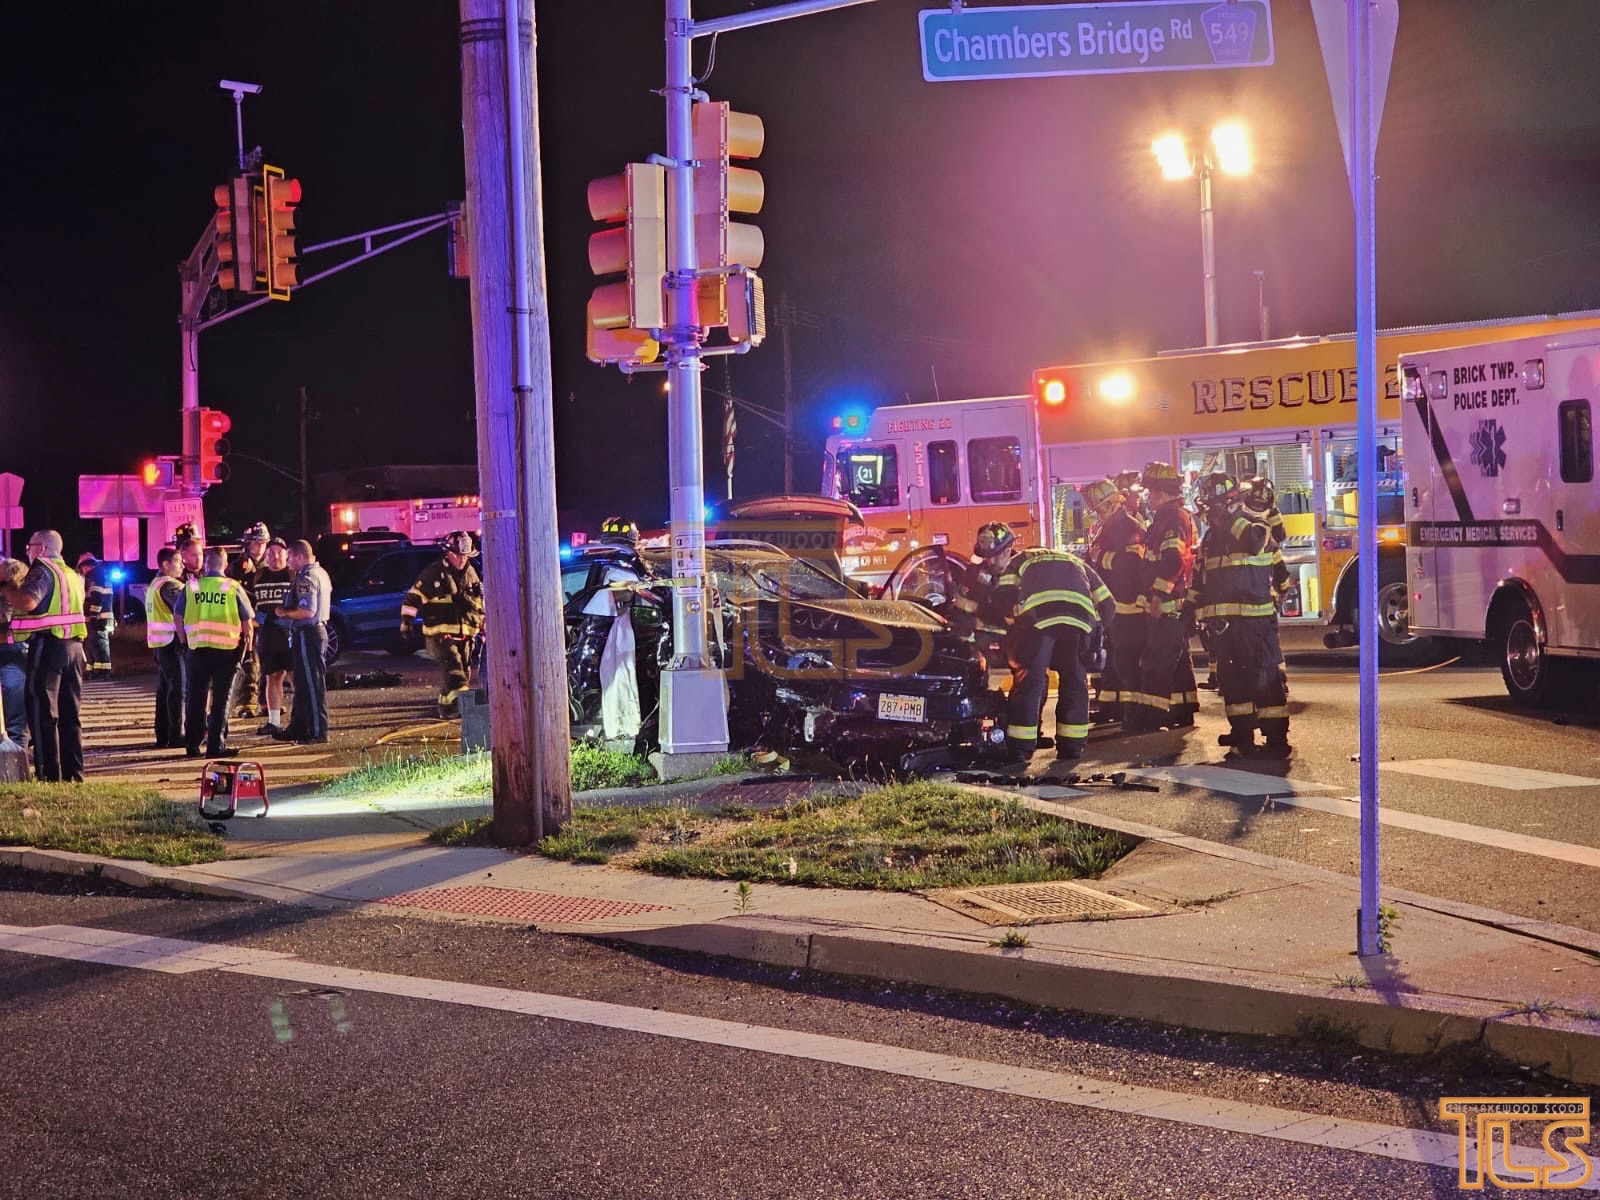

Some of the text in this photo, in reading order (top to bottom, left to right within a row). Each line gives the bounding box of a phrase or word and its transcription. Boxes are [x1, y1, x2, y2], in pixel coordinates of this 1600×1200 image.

[934, 19, 1193, 64] Chambers Bridge Rd
[1210, 22, 1249, 45] 549
[1453, 361, 1519, 385] BRICK TWP.
[1191, 367, 1358, 415] RESCUE
[1454, 387, 1520, 411] POLICE DEPT.
[1419, 527, 1538, 541] EMERGENCY MEDICAL SERVICES
[194, 591, 226, 606] POLICE
